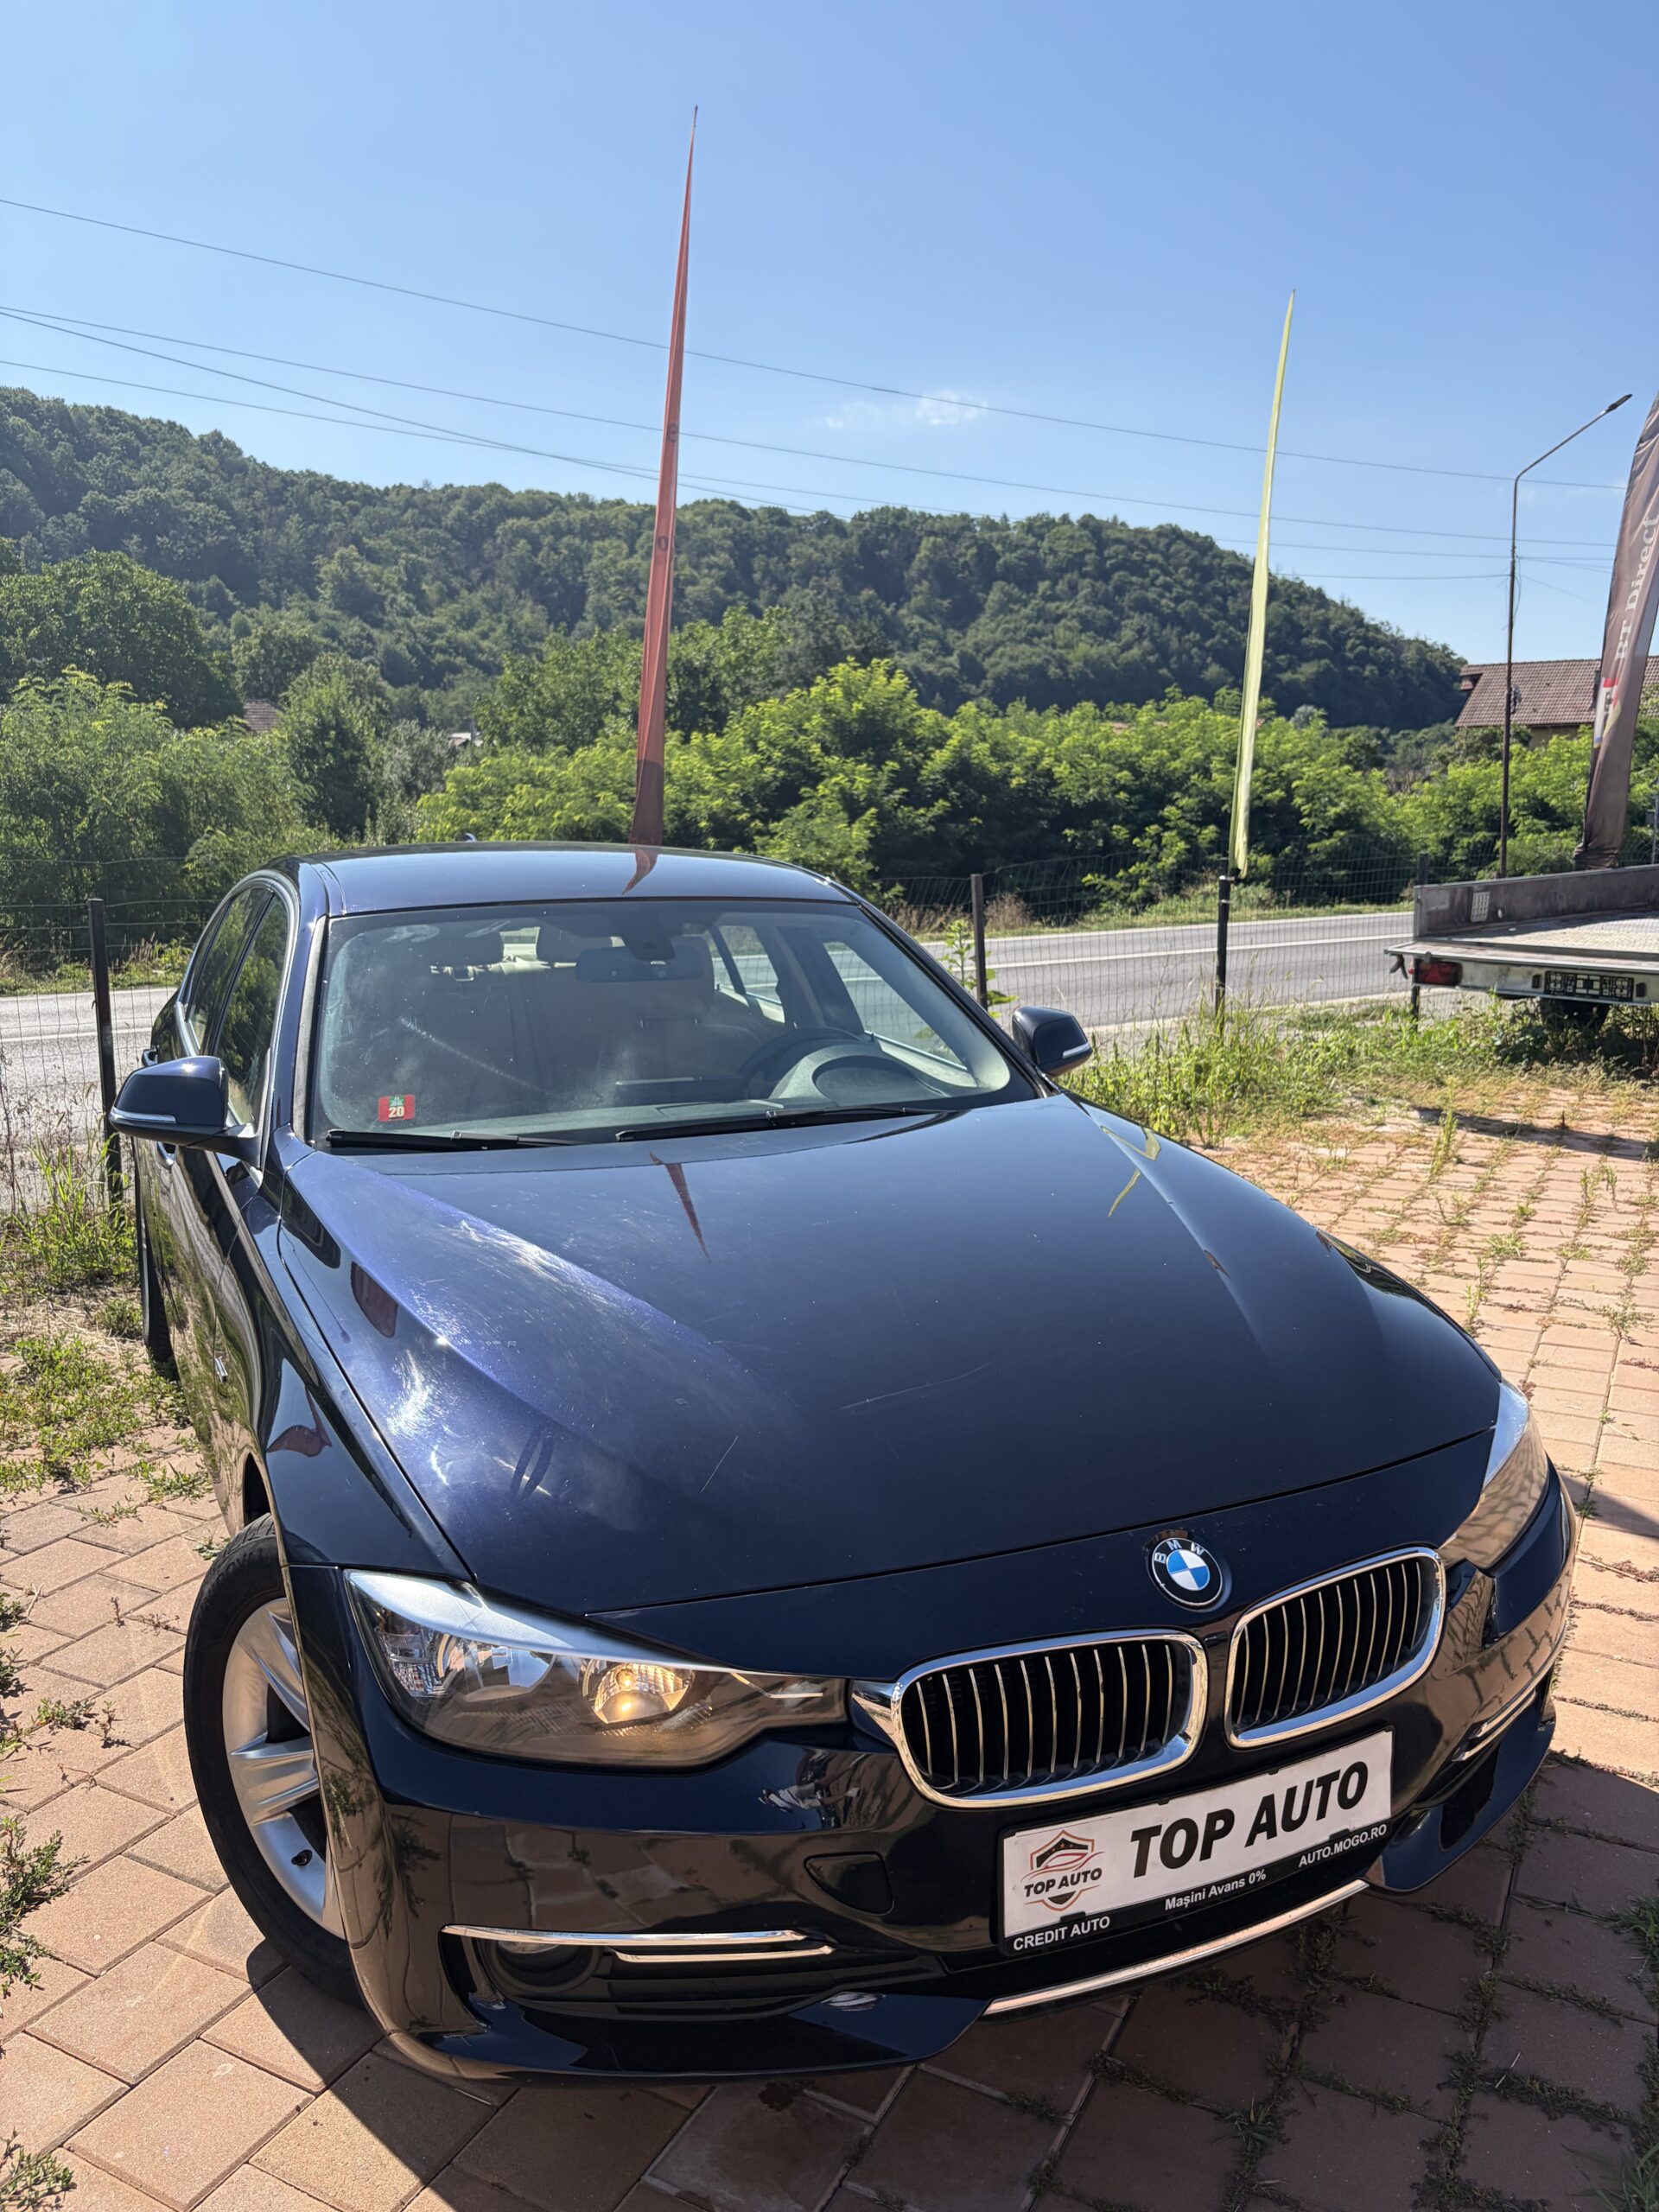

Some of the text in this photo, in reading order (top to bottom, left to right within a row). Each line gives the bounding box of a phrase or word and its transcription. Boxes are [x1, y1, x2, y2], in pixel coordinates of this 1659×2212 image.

[389, 1106, 404, 1118] 20
[1154, 1539, 1205, 1564] BMW
[1130, 1761, 1369, 1878] TOP AUTO
[1298, 1823, 1387, 1868] AUTO.MOGO.RO
[1024, 1867, 1103, 1897] TOP AUTO
[1208, 1878, 1245, 1897] Avans
[1248, 1868, 1267, 1884] 0%
[1013, 1916, 1110, 1950] CREDIT AUTO
